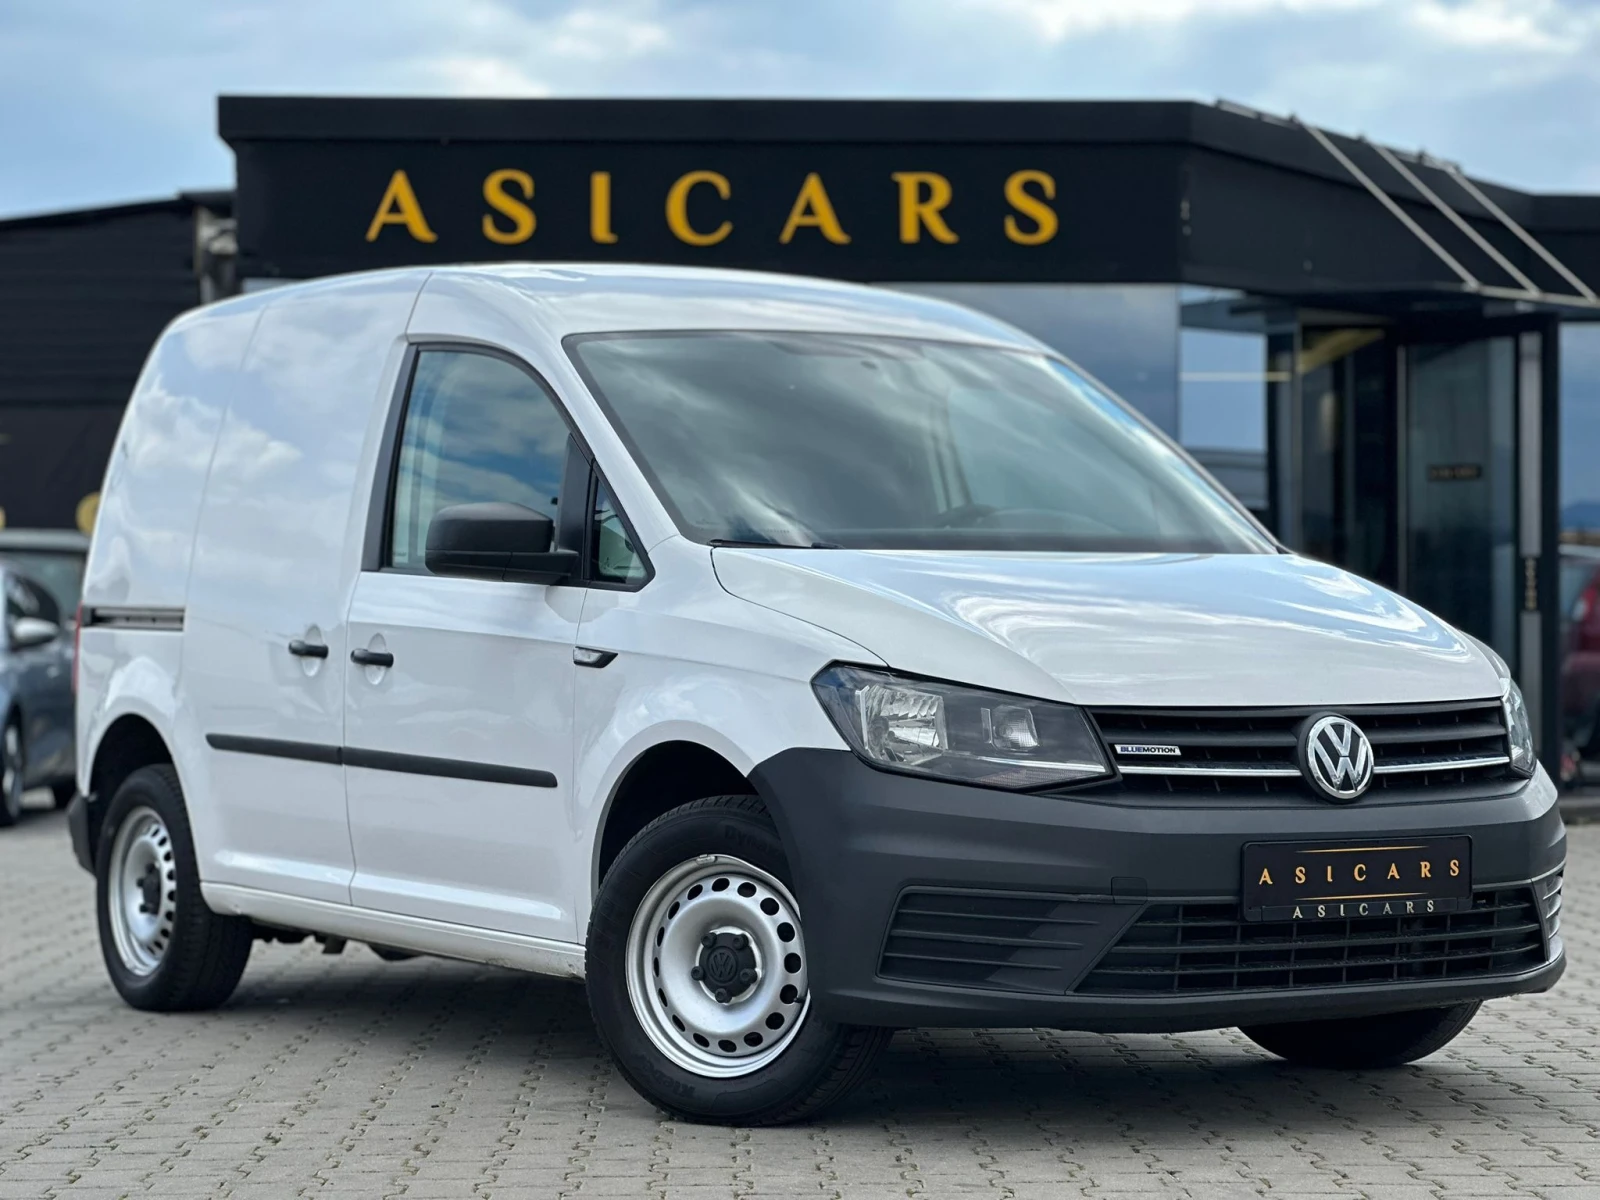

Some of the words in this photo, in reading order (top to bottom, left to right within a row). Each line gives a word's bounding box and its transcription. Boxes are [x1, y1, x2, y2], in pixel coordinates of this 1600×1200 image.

[364, 168, 1060, 246] ASICARS
[1311, 720, 1371, 796] VW
[1259, 860, 1459, 885] ASICARS
[1293, 900, 1434, 919] ASICARS
